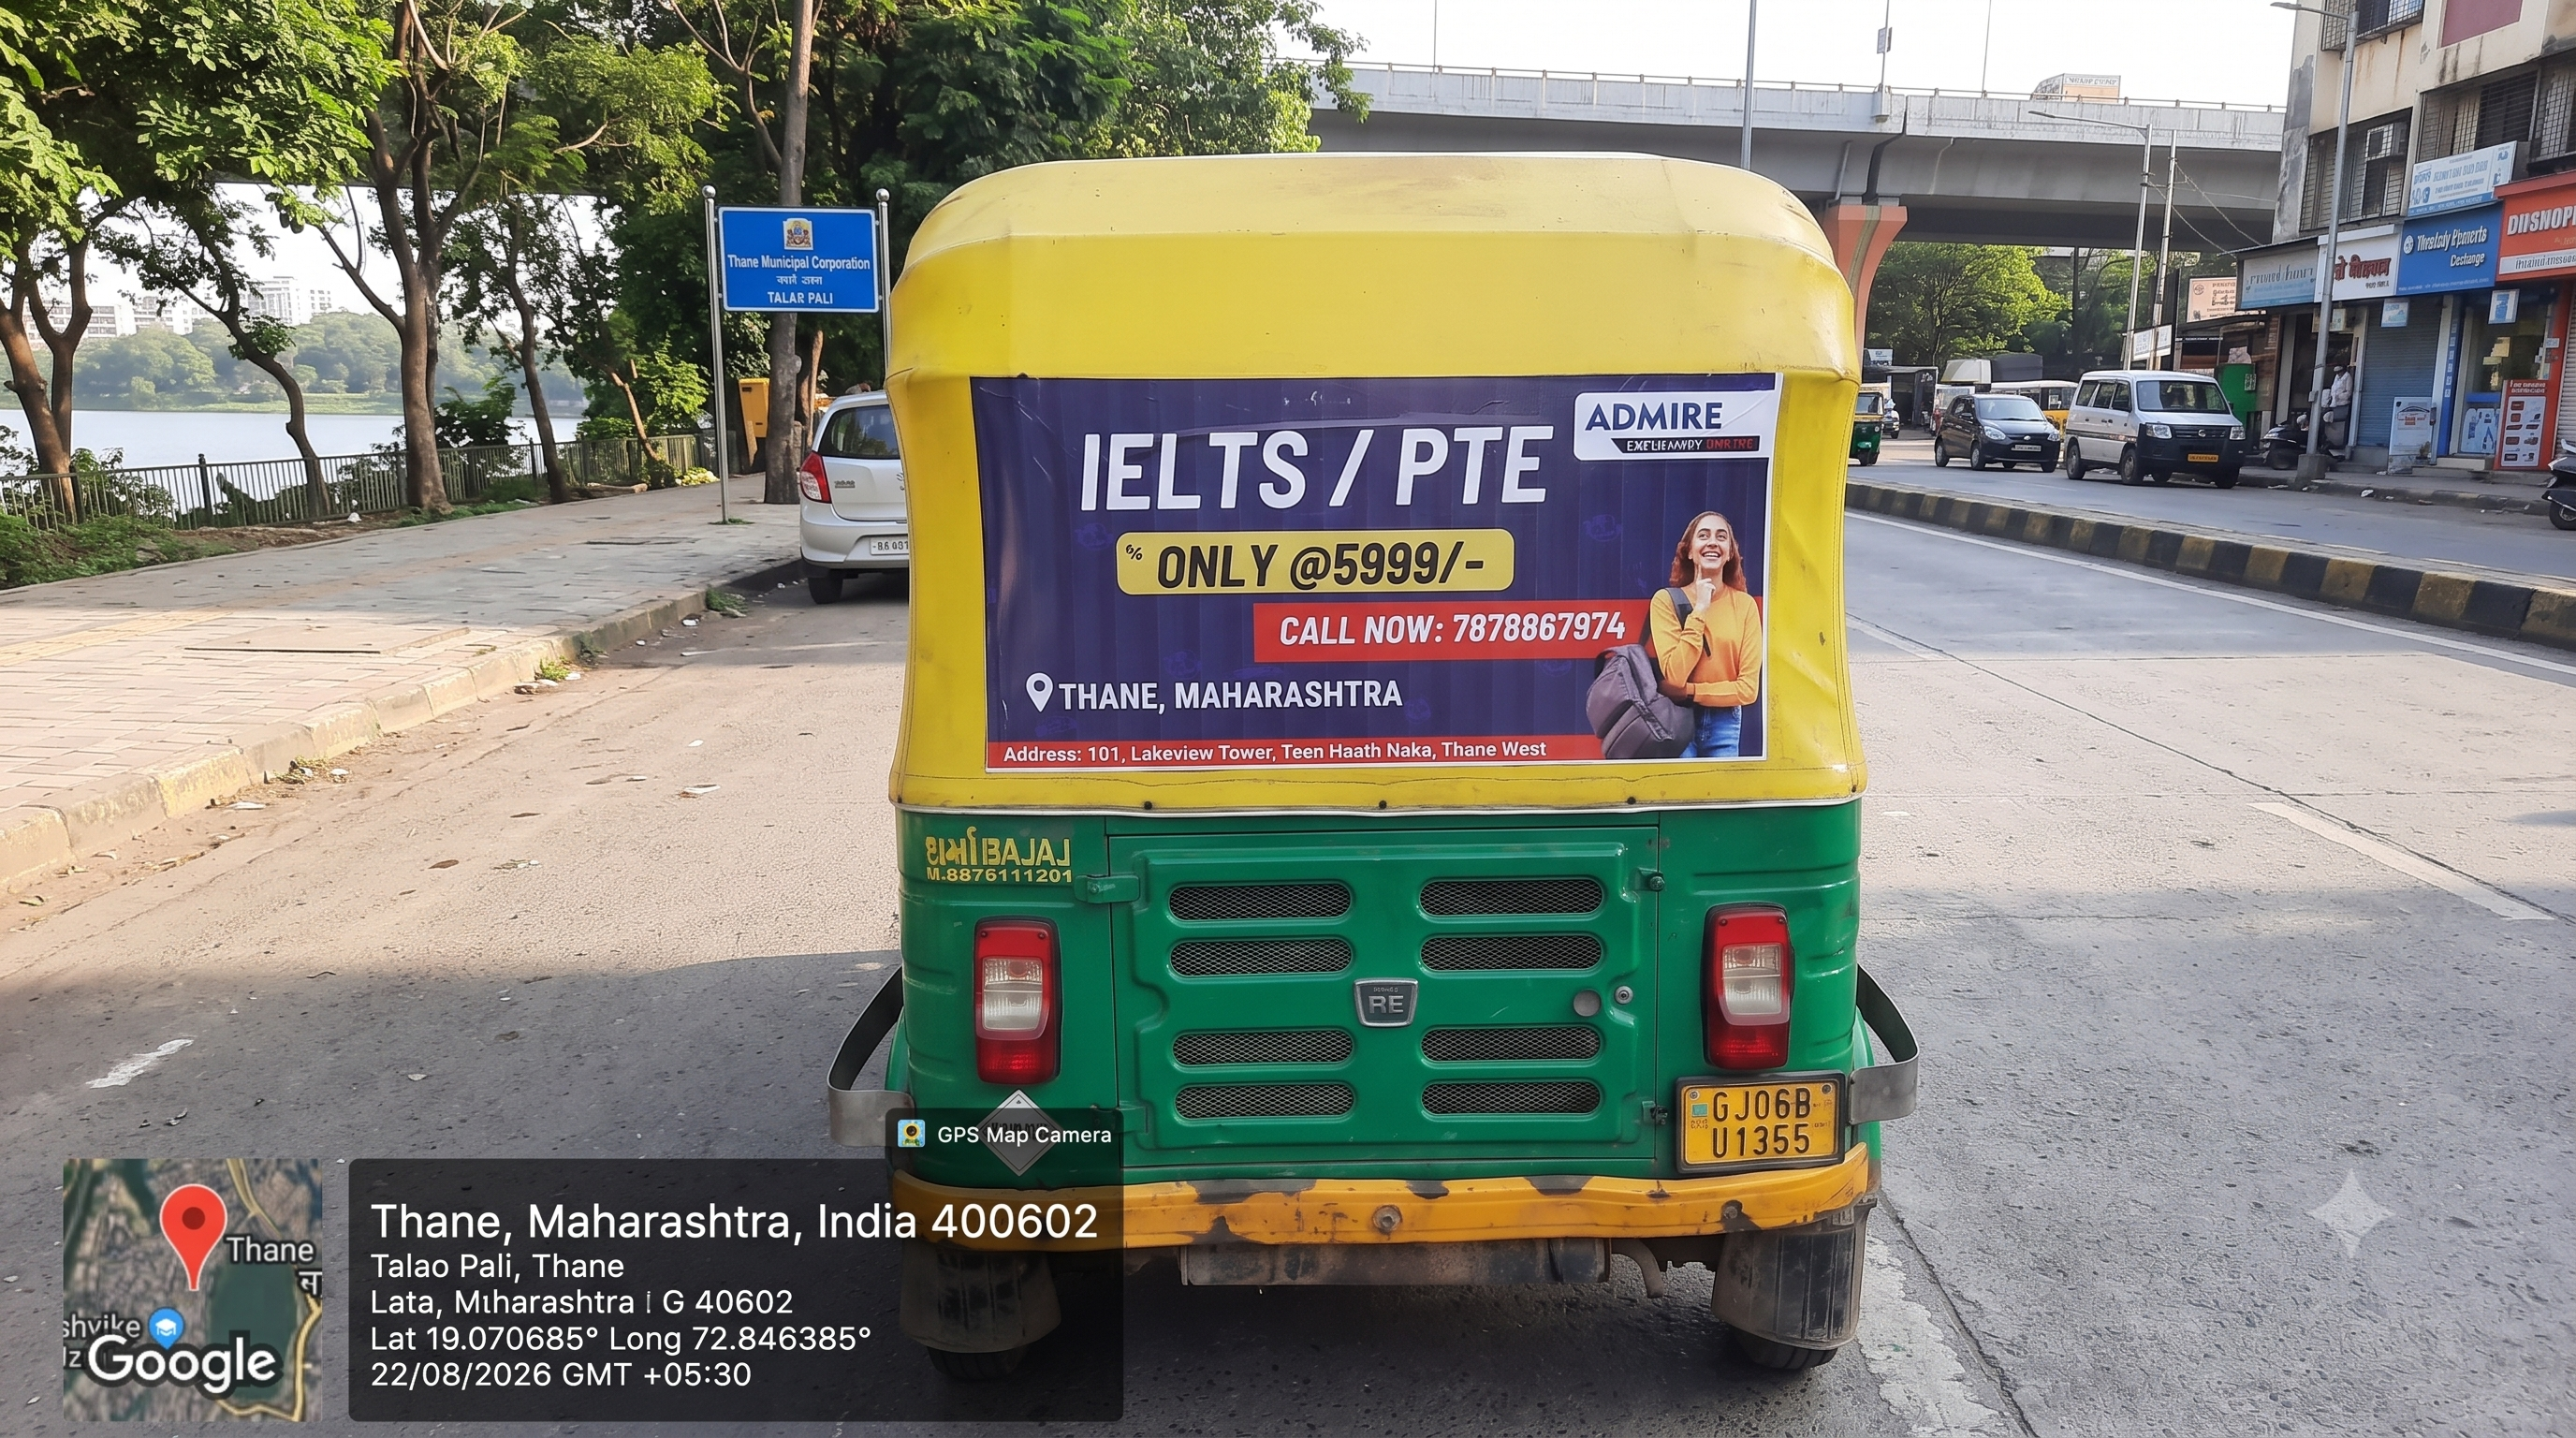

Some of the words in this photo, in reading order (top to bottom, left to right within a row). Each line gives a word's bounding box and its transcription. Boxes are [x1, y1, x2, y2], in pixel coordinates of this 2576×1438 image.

[727, 254, 759, 269] Thane
[761, 255, 810, 271] Municipal
[812, 256, 871, 272] Corporation
[767, 291, 805, 304] TALAR
[808, 292, 833, 305] PALI
[1585, 402, 1723, 431] ADMIRE
[1080, 432, 1310, 511] IELTS
[1328, 429, 1375, 507] /
[1395, 425, 1555, 506] PTE
[1157, 545, 1279, 588] ONLY
[1289, 541, 1485, 590] @5999/-
[1279, 615, 1355, 646] CALL
[1364, 615, 1443, 644] NOW:
[1452, 611, 1627, 643] 7878867974
[1058, 682, 1165, 715] THANE,
[1174, 680, 1404, 710] MAHARASHTRA
[1003, 746, 1082, 762] Address:
[1088, 746, 1126, 764] 101,
[1131, 745, 1214, 761] Lakeview
[1218, 744, 1276, 762] Tower,
[1281, 743, 1324, 759] Teen
[1329, 742, 1381, 758] Haath
[1386, 742, 1437, 760] Naka,
[1442, 741, 1497, 756] Thane
[1501, 741, 1546, 756] West
[982, 838, 1071, 867] BAJAJ
[1368, 995, 1404, 1013] RE
[1713, 1087, 1811, 1123] GJ06B
[1712, 1123, 1809, 1158] U1355
